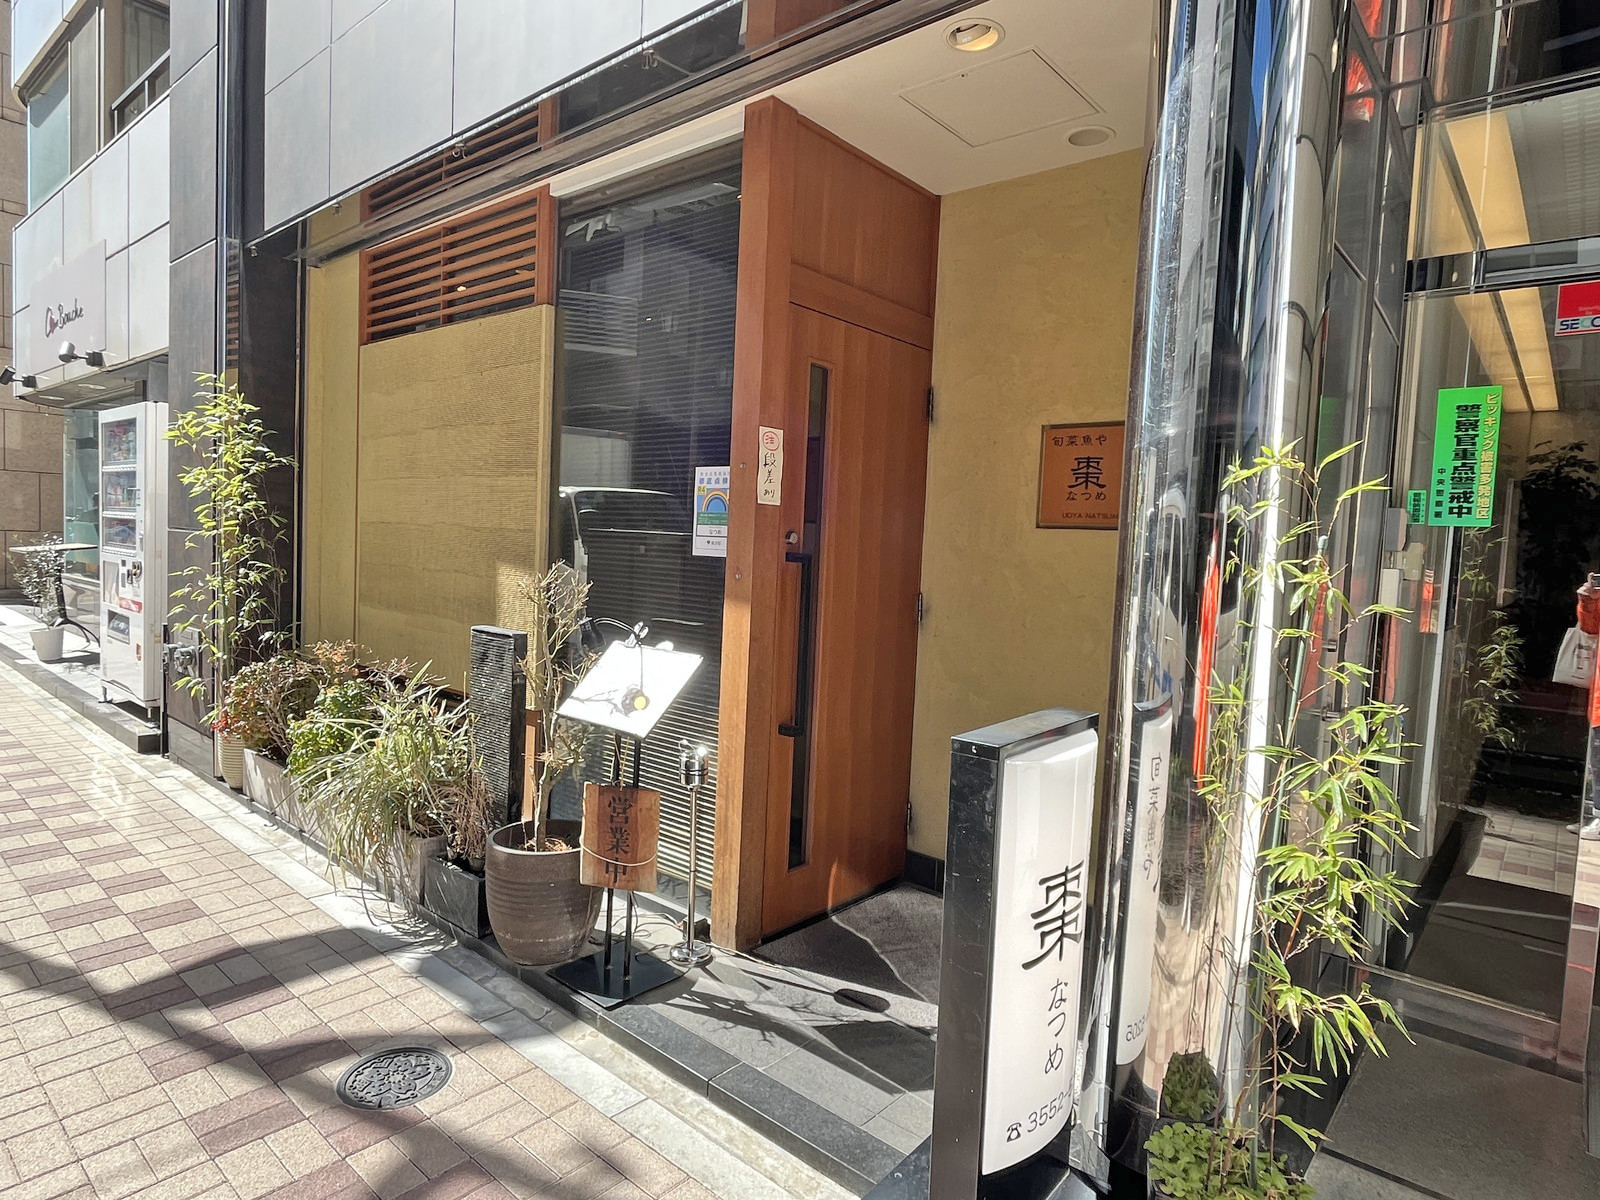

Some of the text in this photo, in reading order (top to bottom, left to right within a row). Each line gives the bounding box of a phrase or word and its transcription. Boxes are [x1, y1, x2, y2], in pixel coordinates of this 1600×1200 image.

[1052, 435, 1108, 447] 旬菜魚や
[1448, 403, 1482, 518] 警察官重点警戒中
[1066, 491, 1107, 501] なつめ
[1067, 456, 1107, 490] 棗
[1084, 512, 1119, 520] NATSUM
[605, 795, 634, 884] 営業中
[1021, 859, 1085, 971] 棗
[1044, 977, 1069, 1075] なつめ
